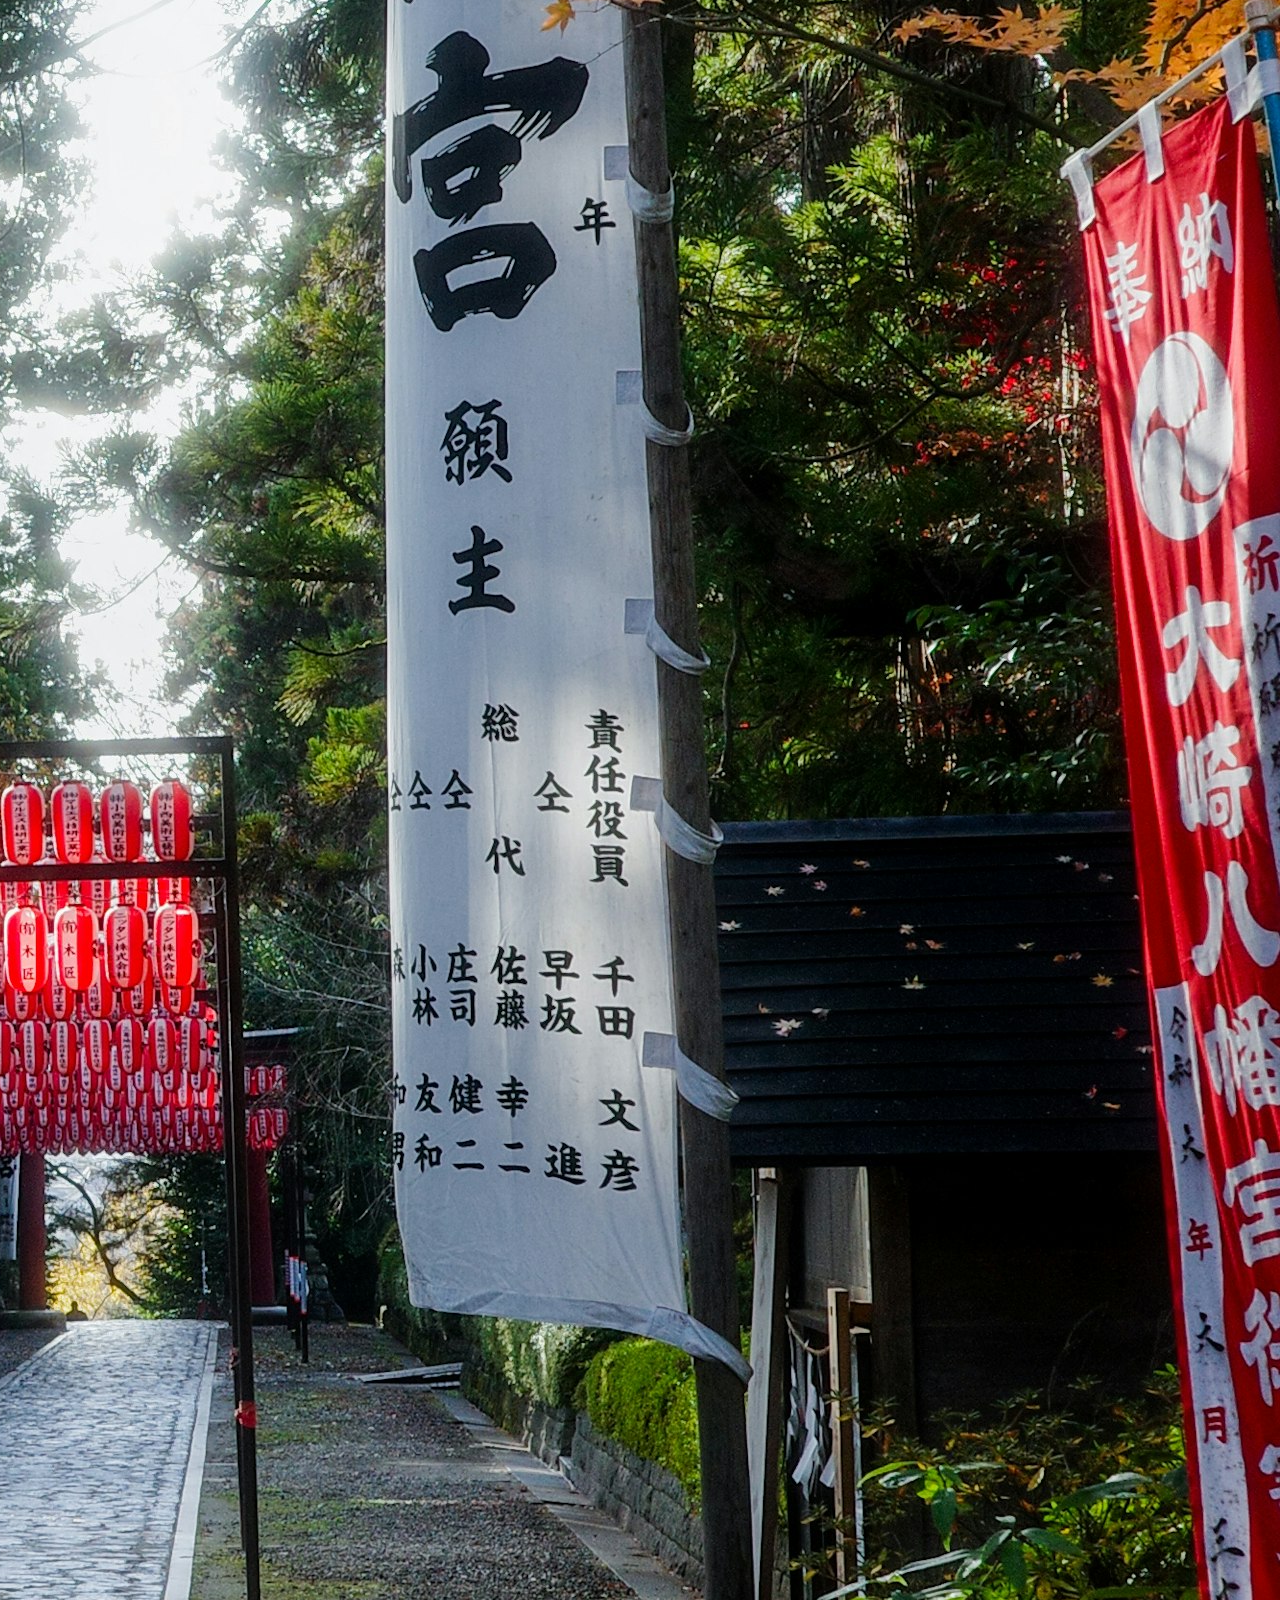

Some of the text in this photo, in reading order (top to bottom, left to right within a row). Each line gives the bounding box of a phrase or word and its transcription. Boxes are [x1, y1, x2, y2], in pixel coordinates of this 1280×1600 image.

[1103, 192, 1235, 346] 奉納
[439, 399, 517, 616] 願主
[410, 943, 443, 1175] 小林友和
[445, 942, 485, 1173] 庄司健二
[490, 944, 532, 1176] 佐藤幸二
[583, 708, 642, 1193] 責任役員 千田文彦
[538, 949, 588, 1186] 早坂進
